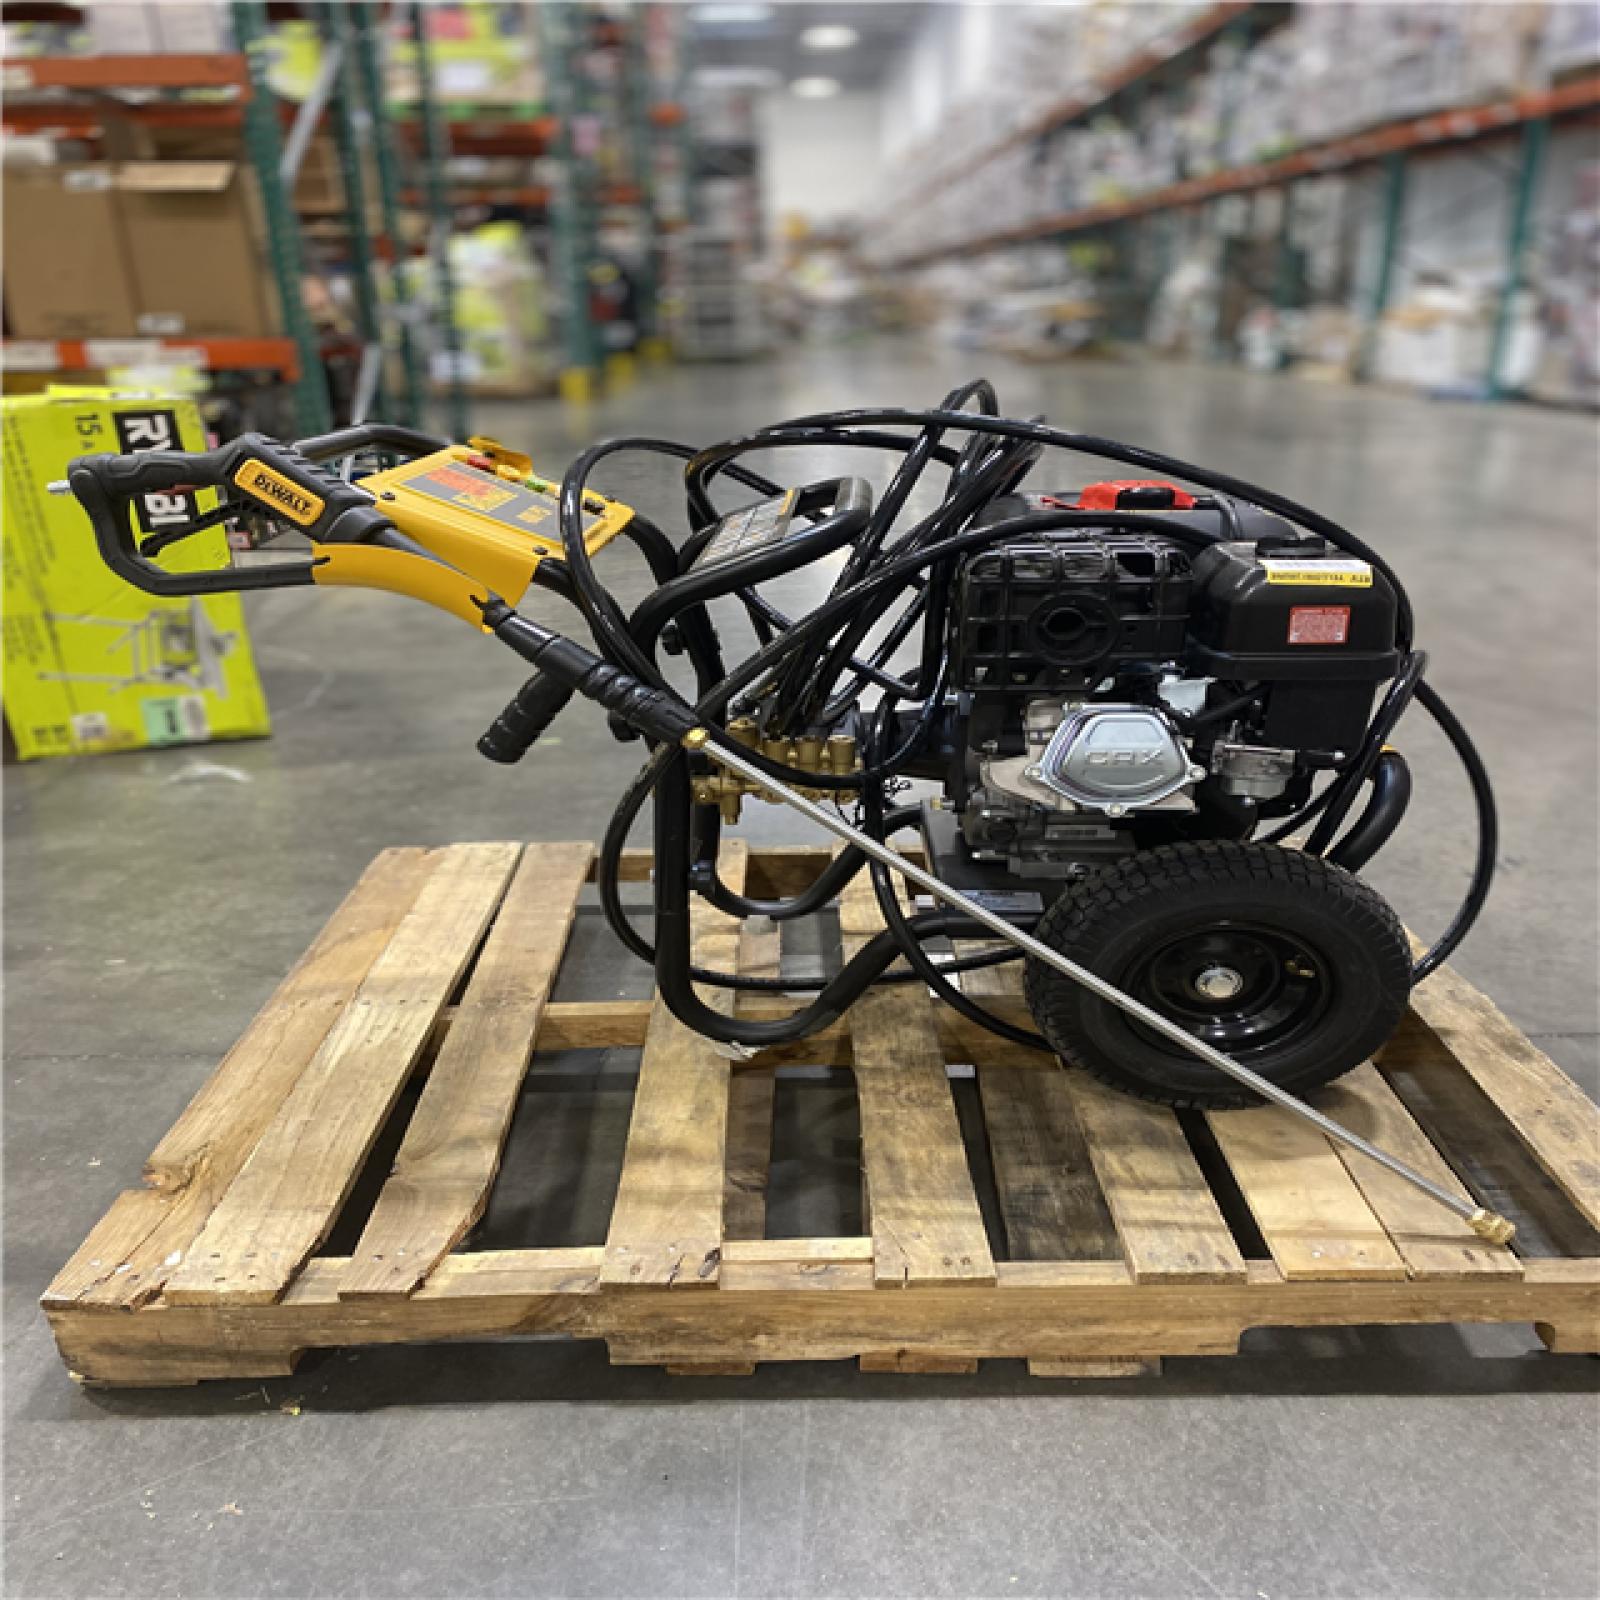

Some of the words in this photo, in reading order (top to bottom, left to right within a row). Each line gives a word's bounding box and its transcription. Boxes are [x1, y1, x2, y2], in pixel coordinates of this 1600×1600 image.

[75, 413, 102, 437] 15
[123, 413, 191, 524] RYBI
[253, 472, 313, 516] DEWALT
